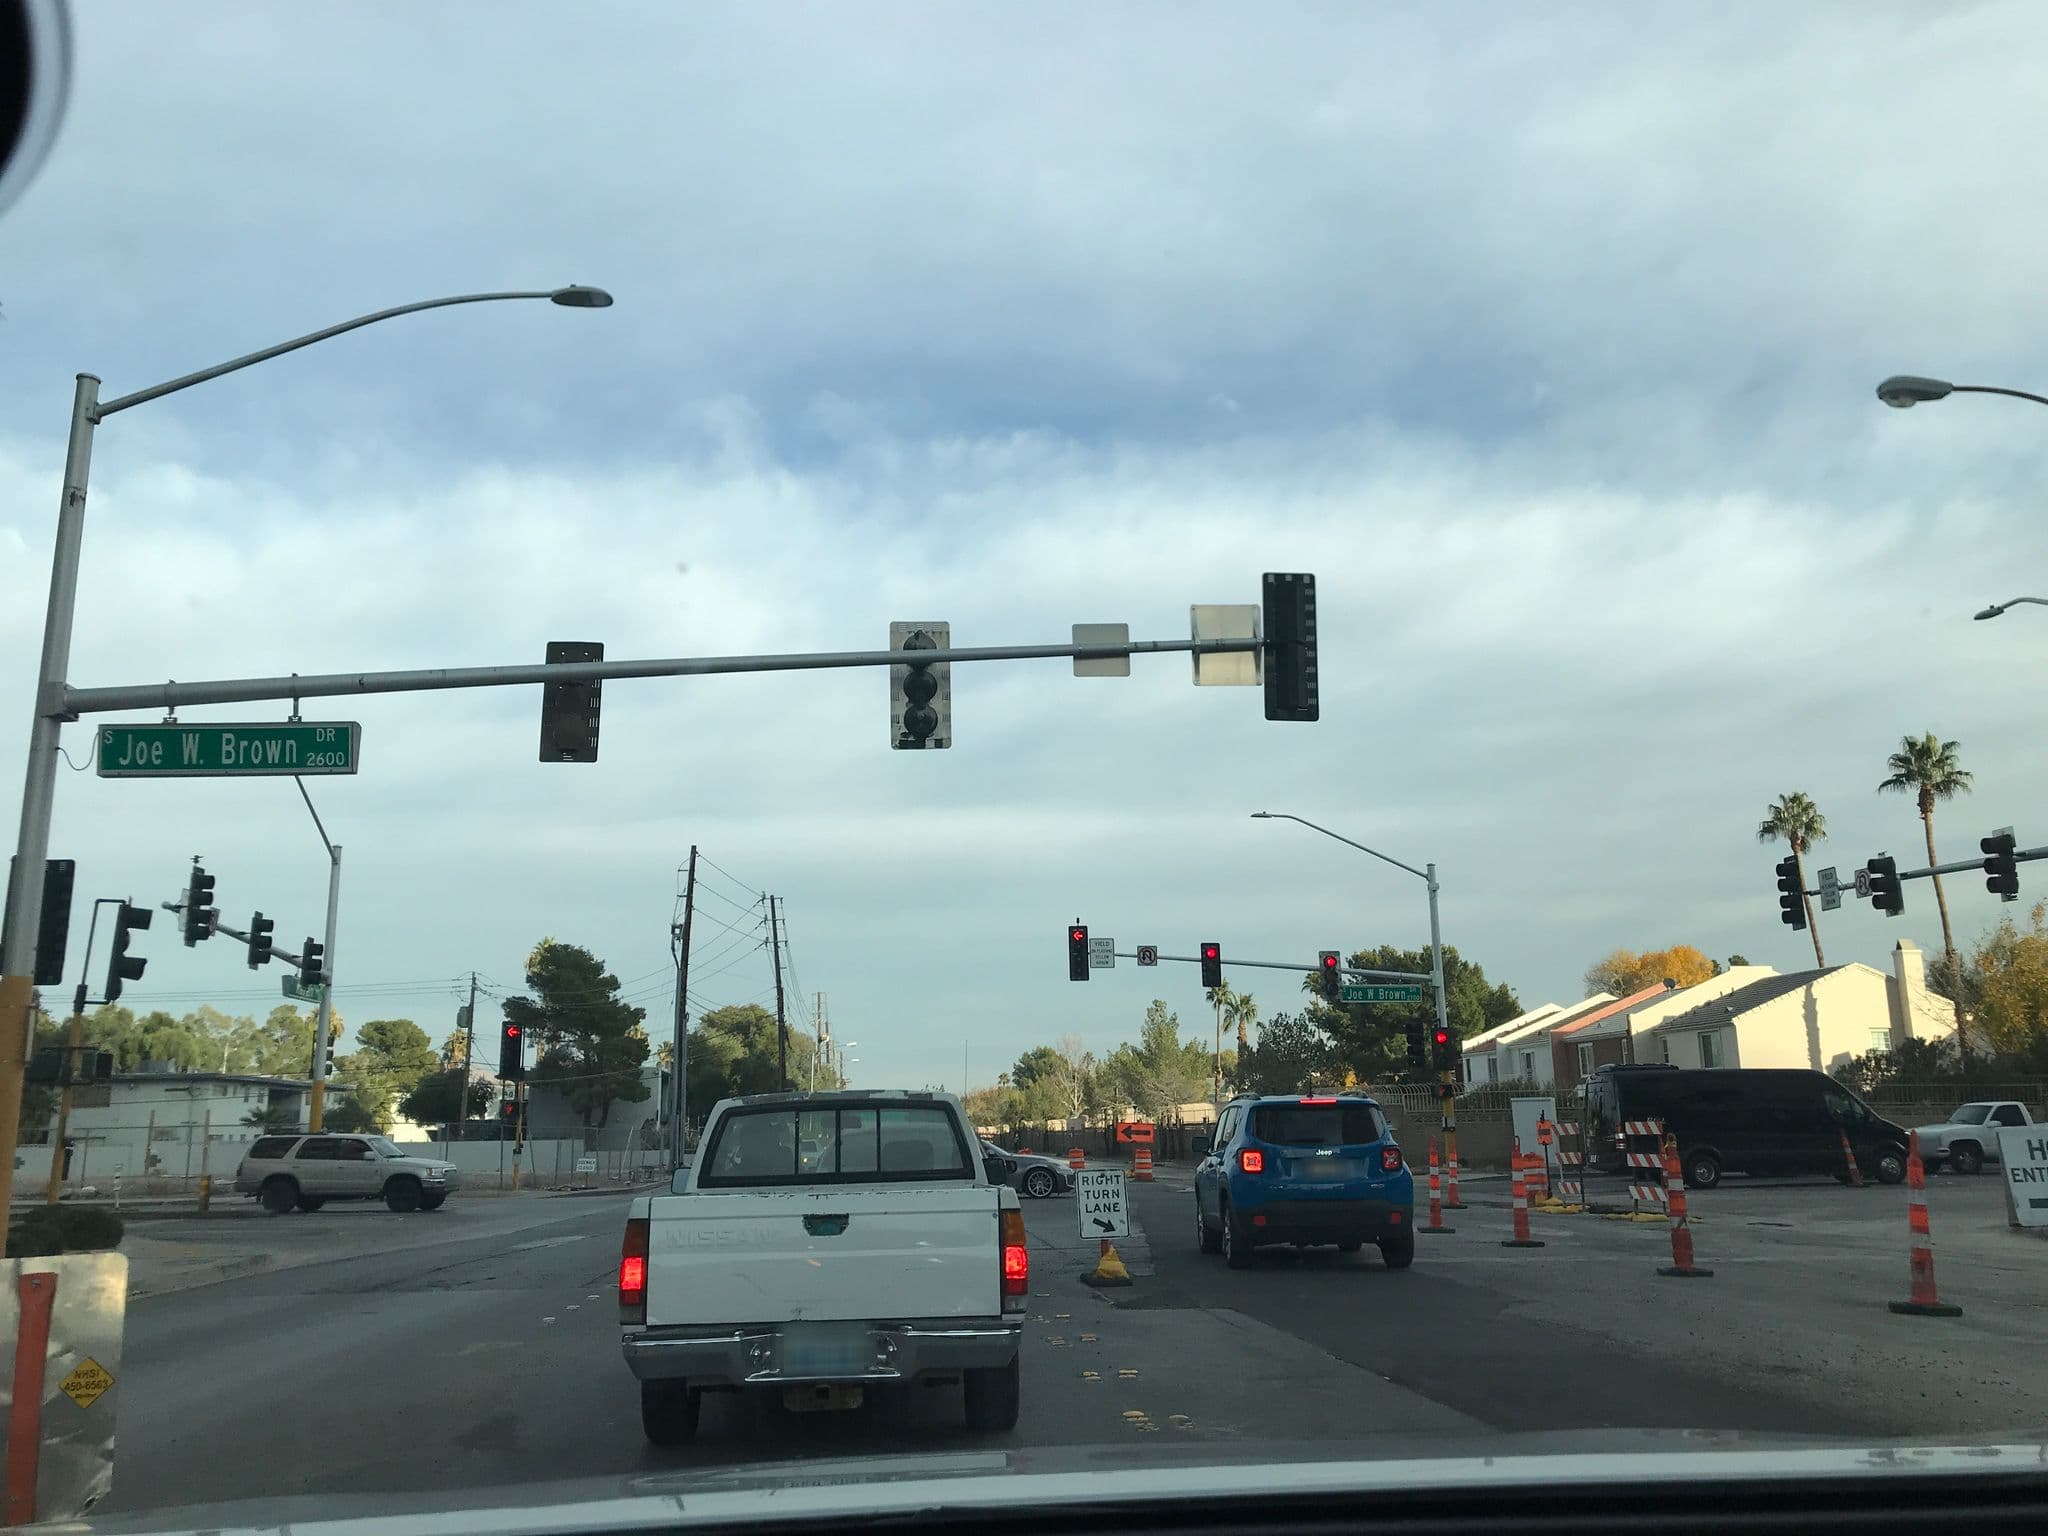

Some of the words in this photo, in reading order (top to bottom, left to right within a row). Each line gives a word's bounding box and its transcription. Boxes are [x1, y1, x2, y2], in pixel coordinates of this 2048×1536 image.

[104, 731, 113, 744] S
[316, 728, 336, 742] DR
[119, 733, 163, 766] Joe
[182, 733, 204, 765] W.
[221, 732, 297, 765] Brown
[306, 751, 345, 767] 2600
[1348, 988, 1363, 999] Joe
[1367, 988, 1374, 999] W
[1379, 988, 1406, 999] Brown
[2027, 1139, 2048, 1160] H
[1082, 1174, 1121, 1186] RIGHT
[2011, 1167, 2048, 1183] ENT
[1084, 1189, 1120, 1200] TURN
[1085, 1202, 1121, 1213] LANE
